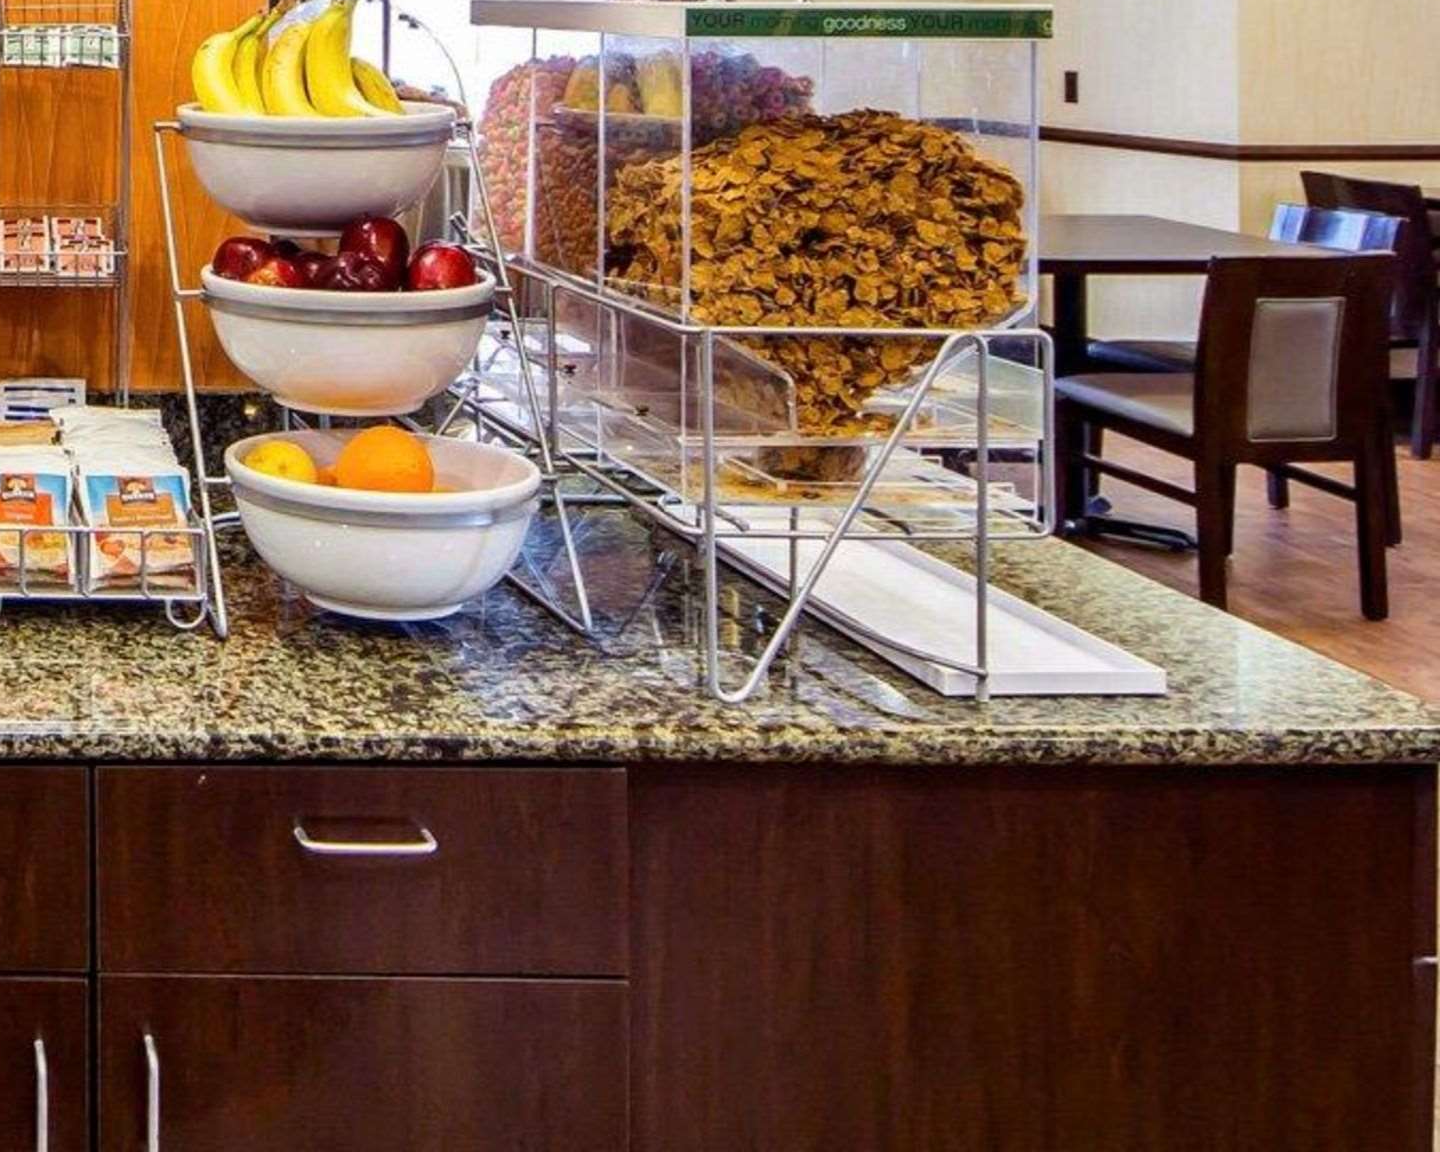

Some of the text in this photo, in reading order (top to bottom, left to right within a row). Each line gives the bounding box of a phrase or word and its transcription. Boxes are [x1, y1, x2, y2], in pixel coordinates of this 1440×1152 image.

[692, 12, 744, 28] YOUR
[823, 15, 906, 33] goodness
[910, 14, 963, 30] YOUR
